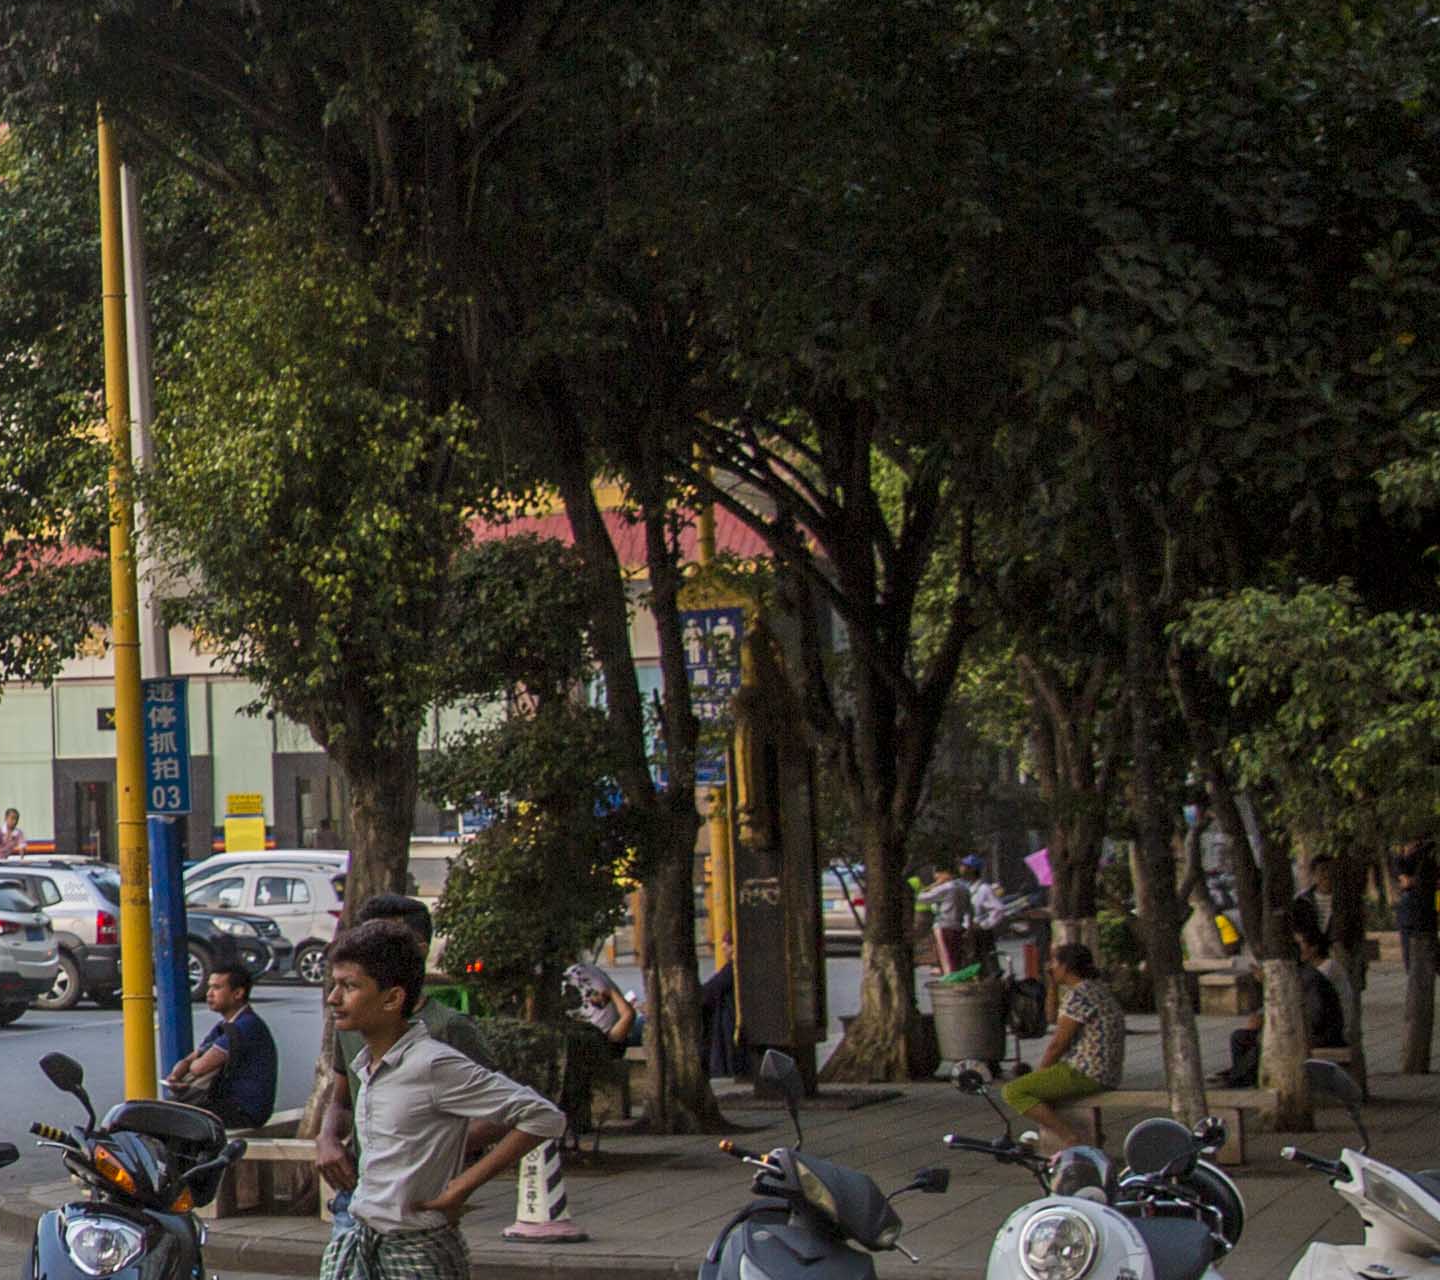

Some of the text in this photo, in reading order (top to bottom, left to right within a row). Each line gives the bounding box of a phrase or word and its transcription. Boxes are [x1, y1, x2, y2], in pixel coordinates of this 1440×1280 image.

[147, 683, 181, 809] 违停抓拍 03
